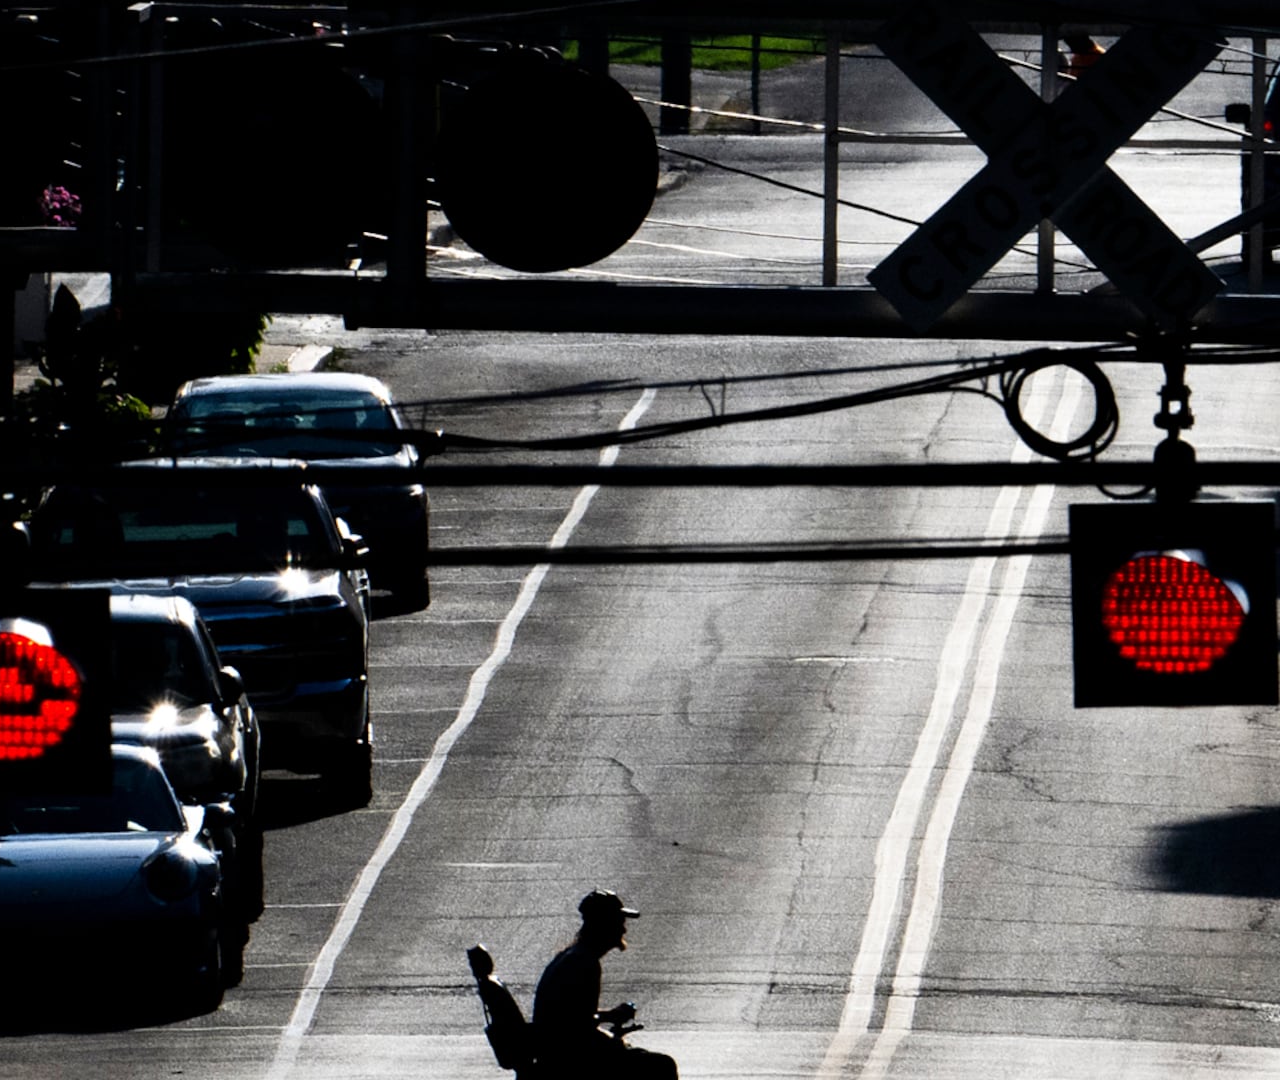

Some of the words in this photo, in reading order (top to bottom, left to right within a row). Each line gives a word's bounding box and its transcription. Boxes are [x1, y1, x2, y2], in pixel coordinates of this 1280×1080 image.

[887, 4, 1005, 135] RAIL
[1074, 184, 1203, 314] ROAD
[900, 20, 1198, 302] CROSSING
